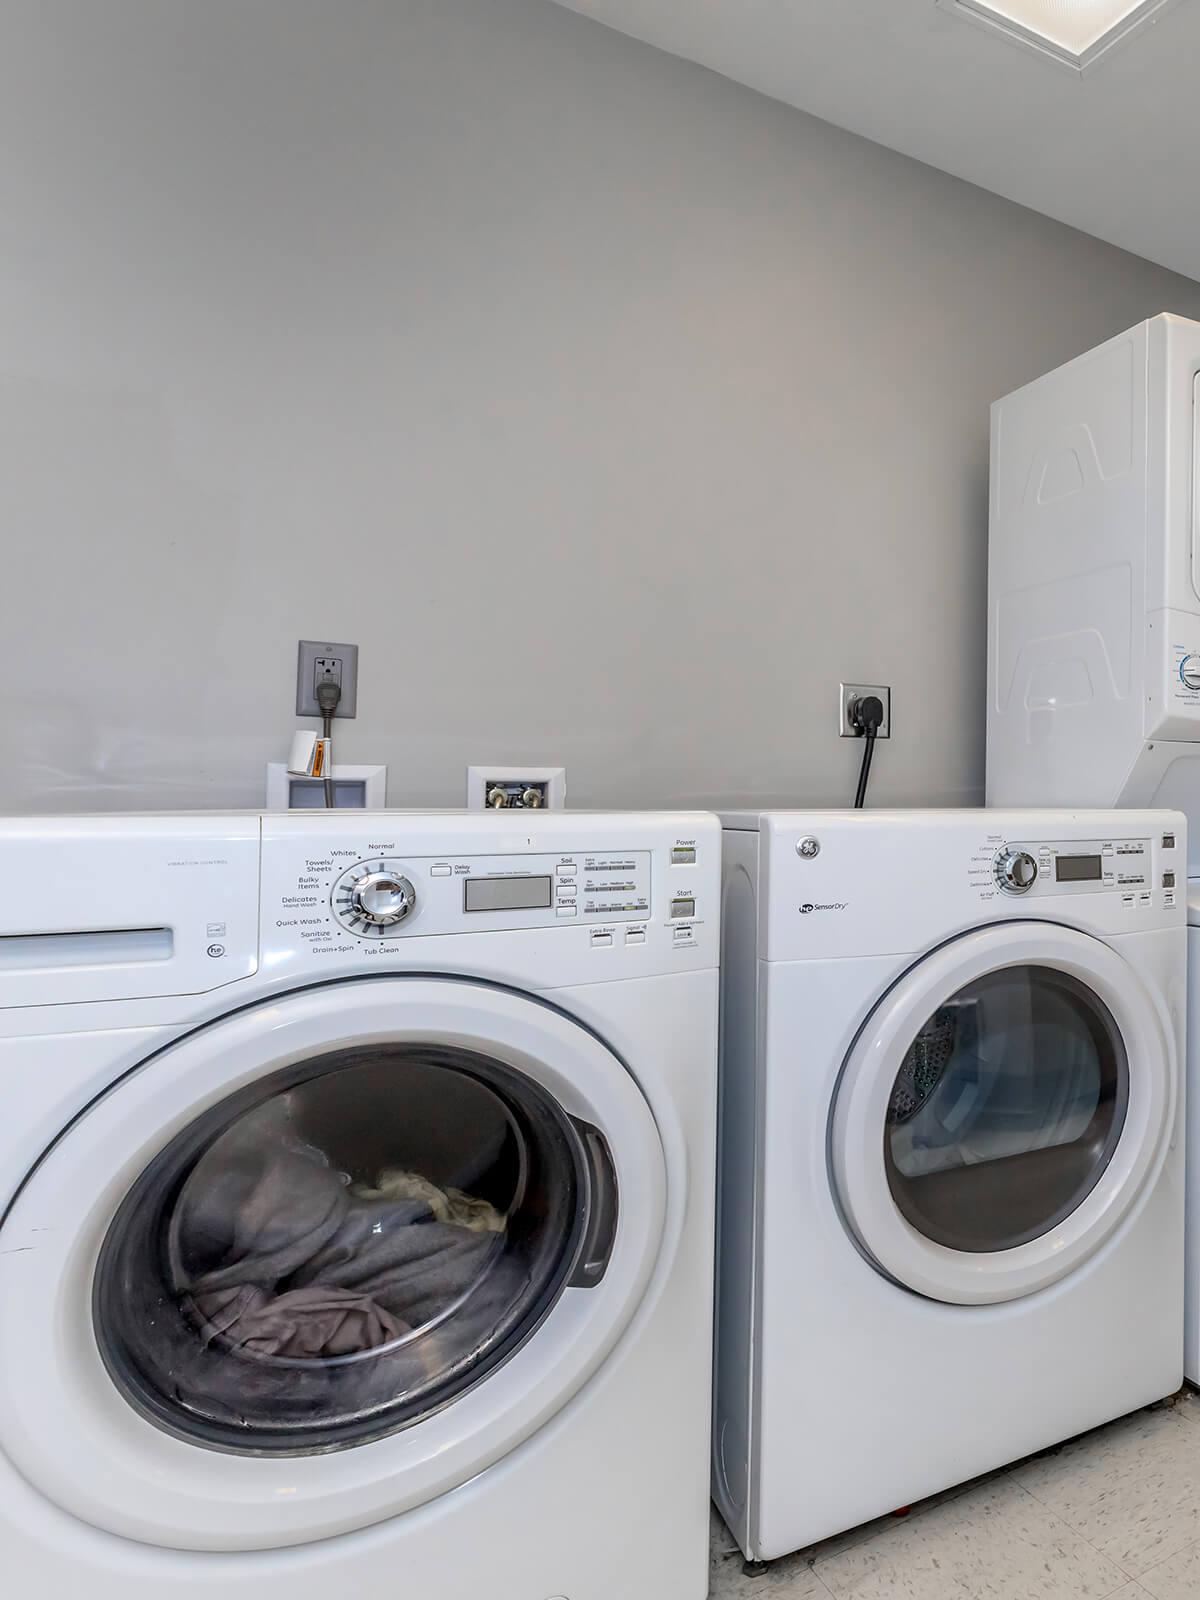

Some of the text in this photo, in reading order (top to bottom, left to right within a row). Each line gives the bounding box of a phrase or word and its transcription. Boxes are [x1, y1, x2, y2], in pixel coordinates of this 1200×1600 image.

[304, 858, 334, 866] Towels/
[281, 896, 317, 904] Delicates
[275, 919, 298, 927] Quick
[300, 930, 331, 938] Sanitize
[312, 945, 354, 954] Drain+Spin
[378, 946, 399, 954] Clean
